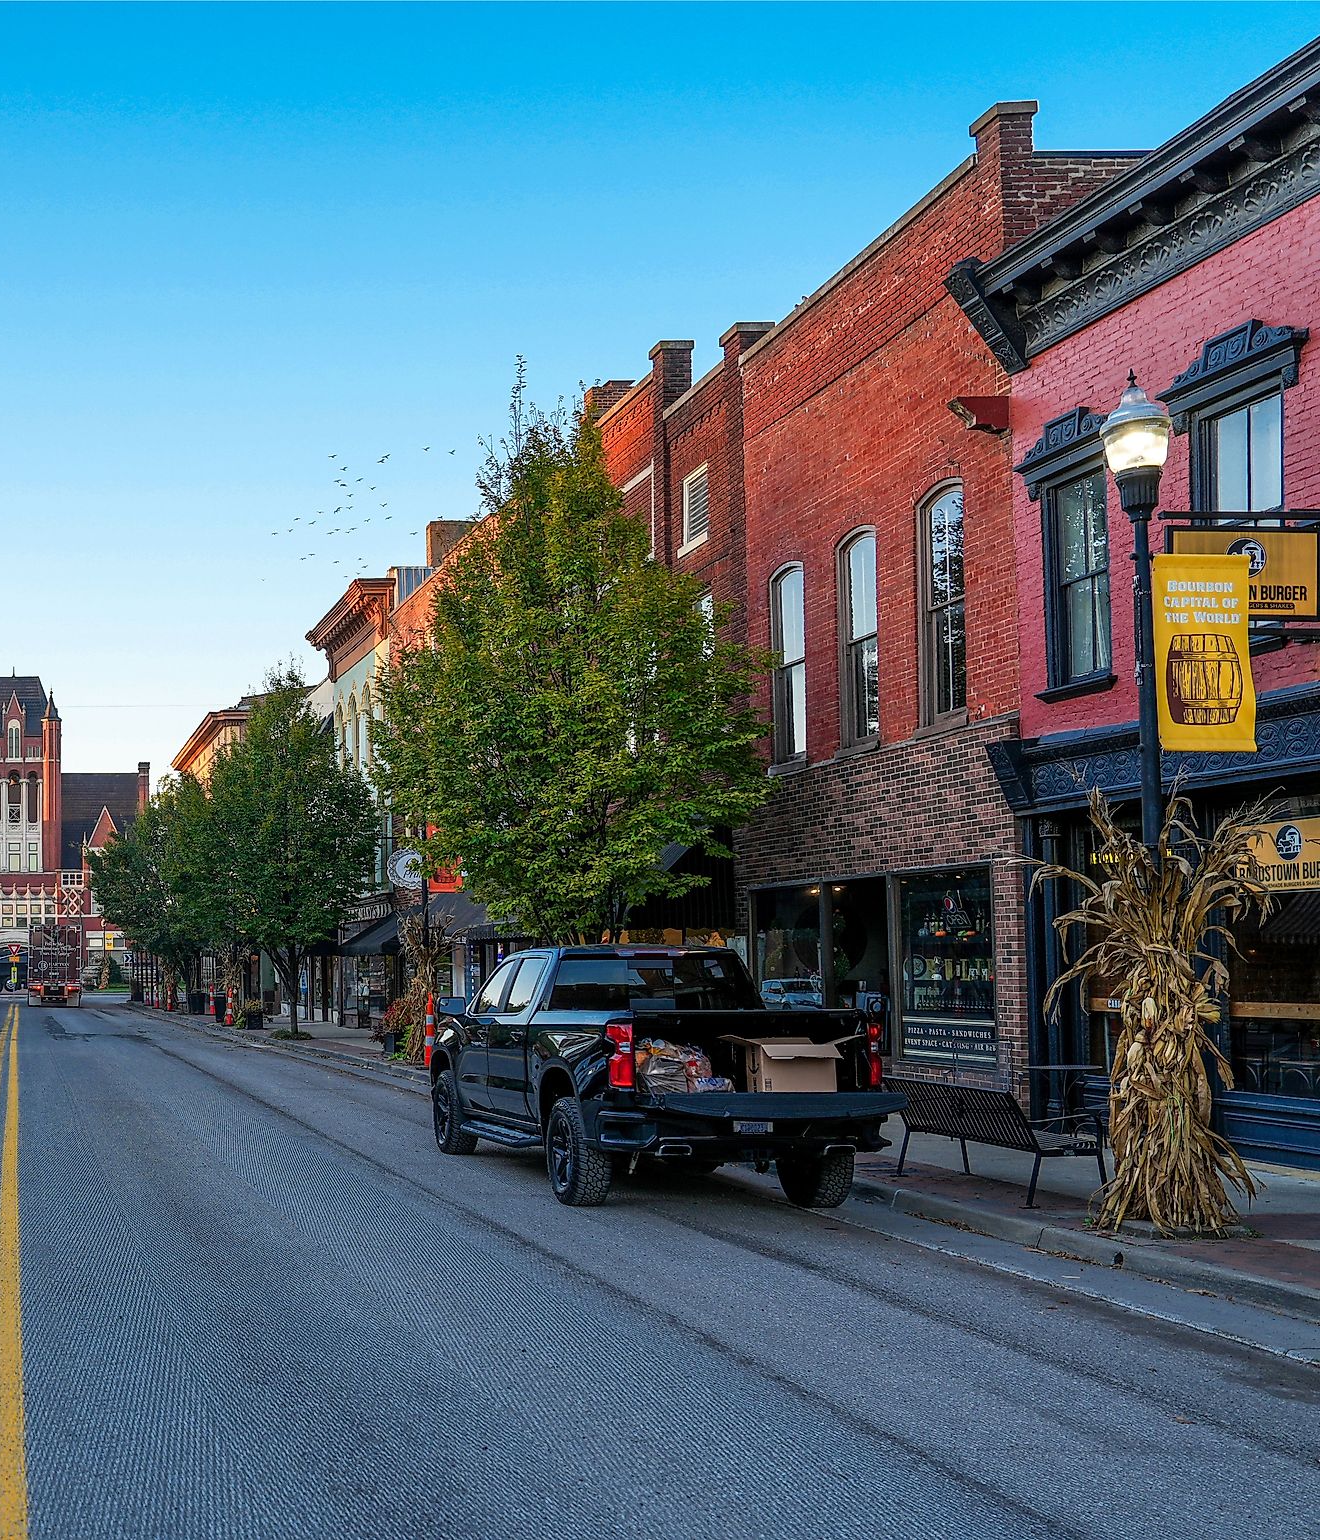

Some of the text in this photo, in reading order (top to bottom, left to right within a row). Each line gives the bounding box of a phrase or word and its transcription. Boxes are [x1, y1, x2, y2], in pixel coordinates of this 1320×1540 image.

[1260, 585, 1308, 601] BURGER
[907, 1026, 991, 1039] PIZZA PASTA SANDWICHES
[904, 1038, 921, 1046] EVENT
[921, 1039, 938, 1047] SPACE
[973, 1043, 984, 1051] AIR
